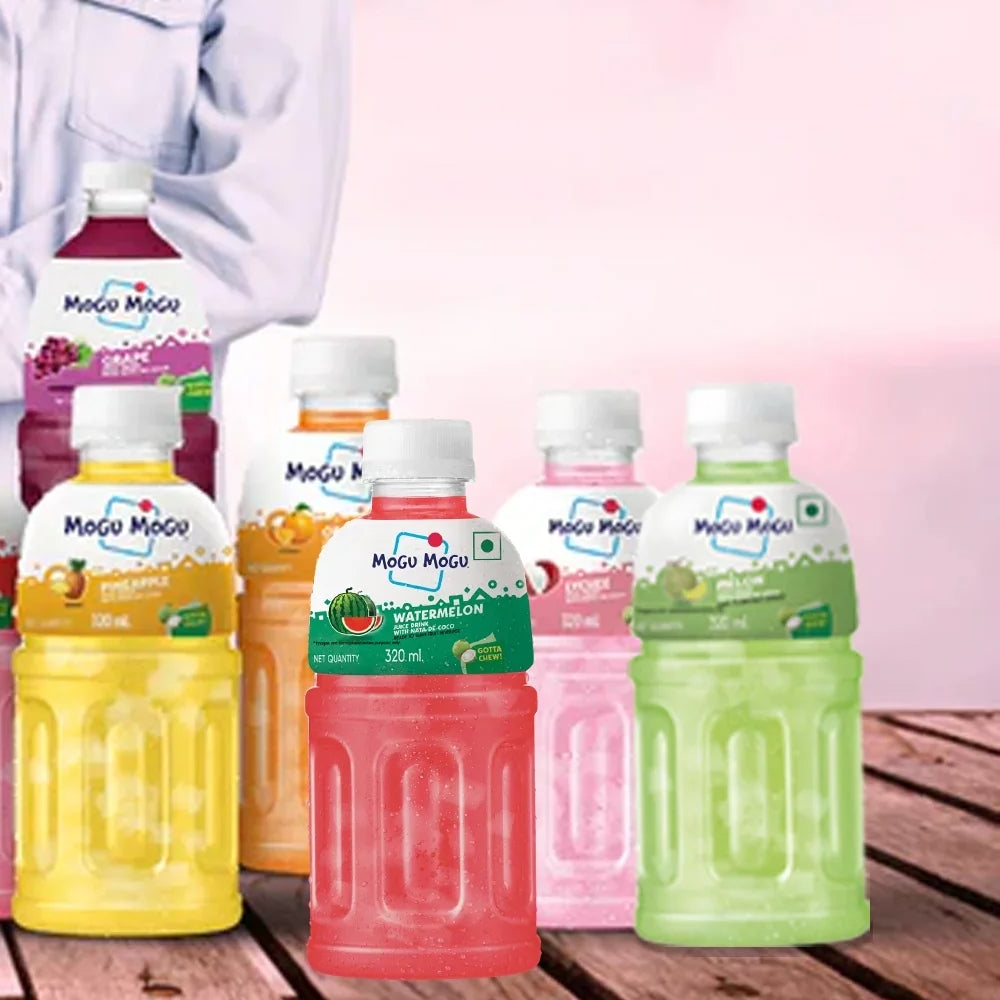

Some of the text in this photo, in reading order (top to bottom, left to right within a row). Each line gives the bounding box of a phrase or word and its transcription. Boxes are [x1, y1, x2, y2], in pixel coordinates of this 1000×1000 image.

[393, 604, 484, 623] WATERMELON
[385, 648, 405, 663] 320
[477, 645, 502, 654] GOTTA
[313, 654, 360, 663] NET QUANTITY
